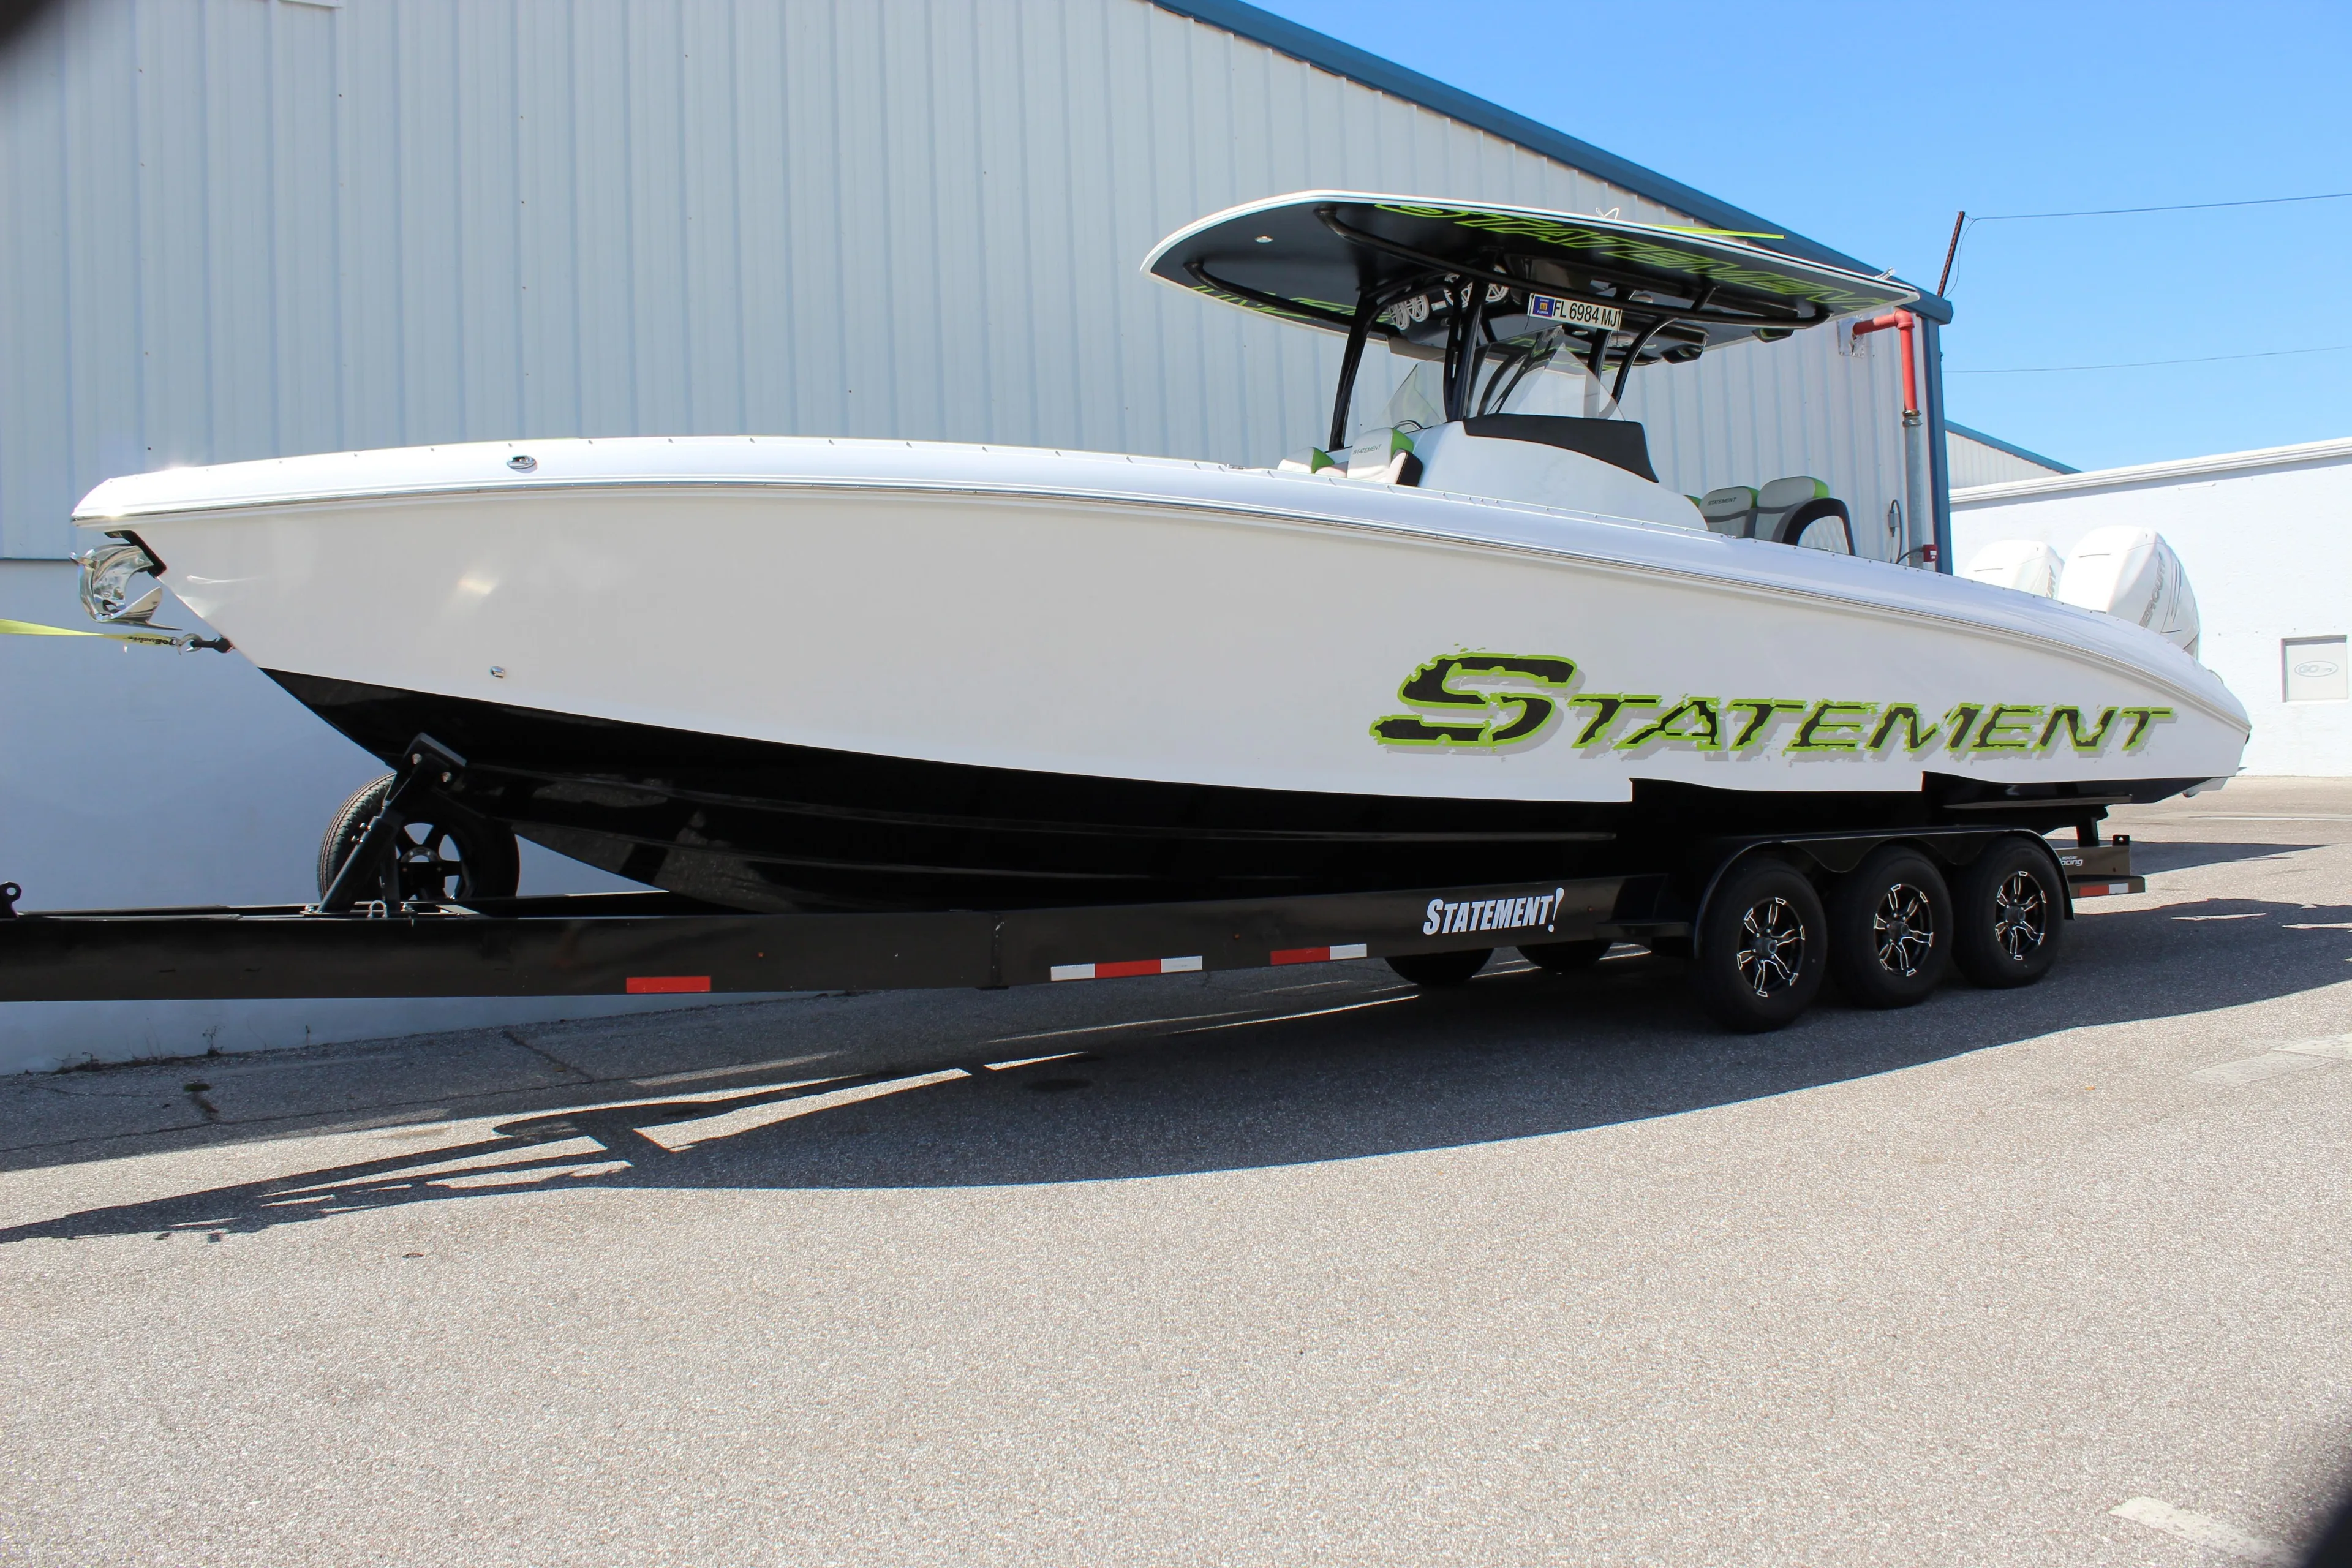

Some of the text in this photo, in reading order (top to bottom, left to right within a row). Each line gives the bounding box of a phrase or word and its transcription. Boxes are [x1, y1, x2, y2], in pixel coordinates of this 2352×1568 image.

[1553, 299, 1567, 318] FL
[1569, 303, 1599, 323] 6984
[1600, 308, 1618, 327] MJ
[1352, 438, 1382, 455] STATEMENT
[1707, 497, 1737, 506] STATEMENT
[1369, 650, 2176, 753] STATEMENT
[1423, 887, 1564, 935] STATEMENT!
